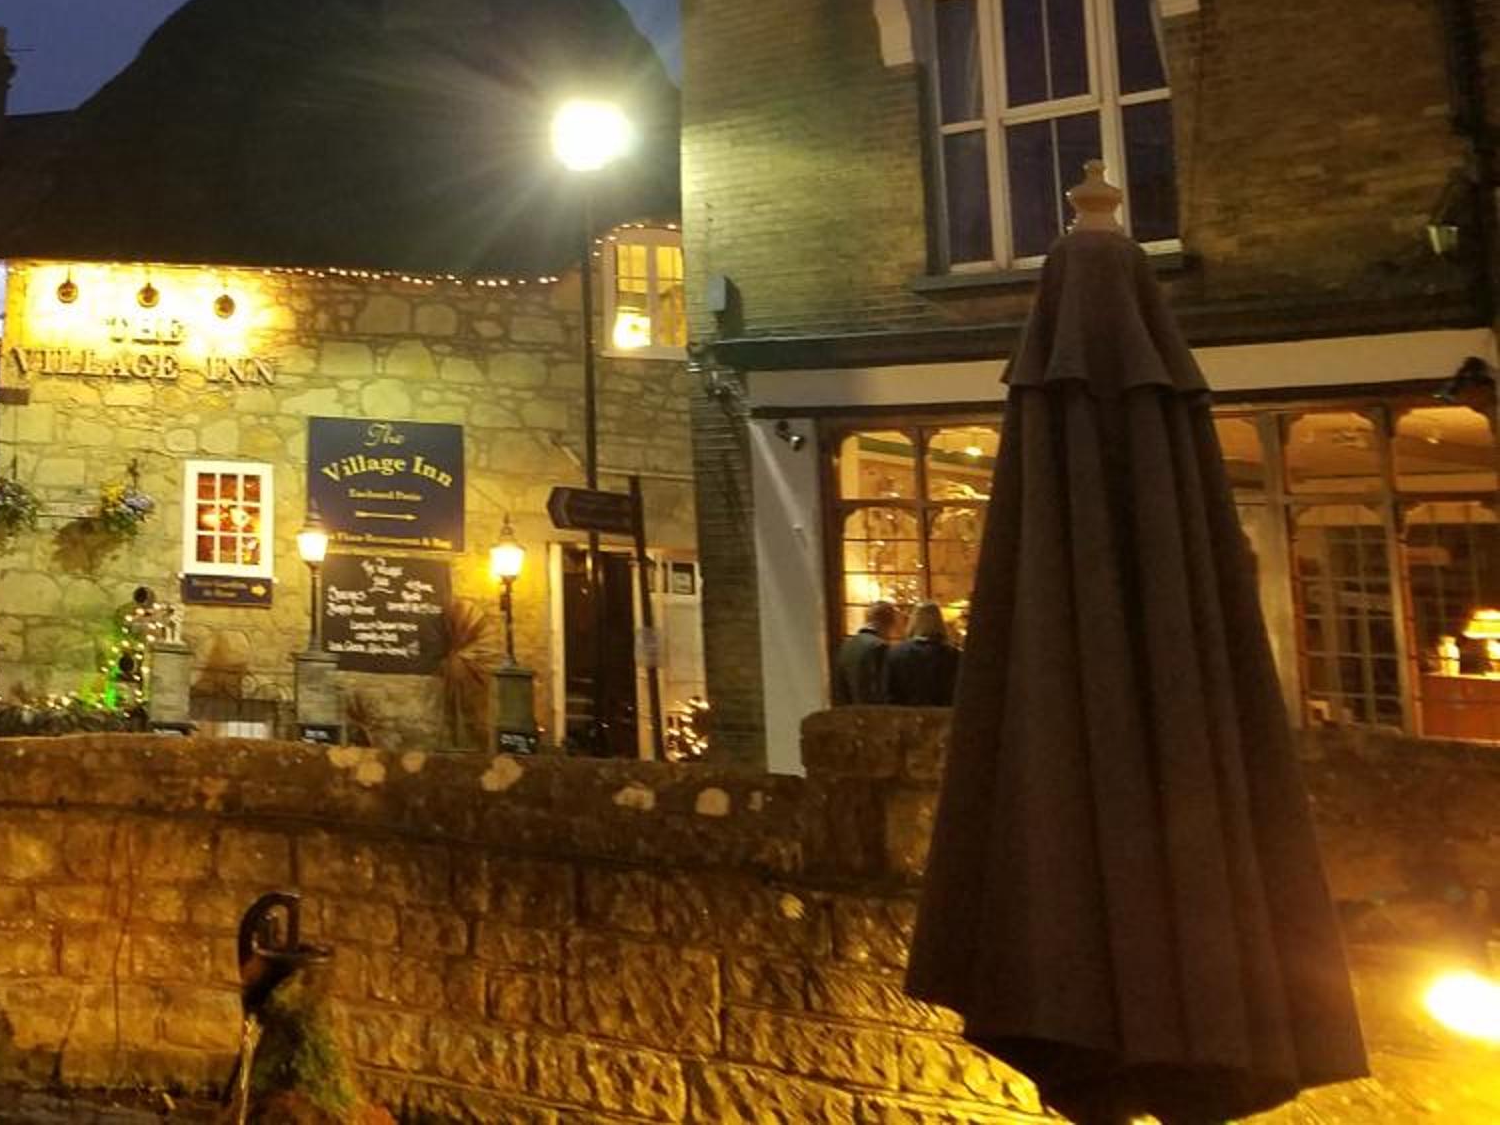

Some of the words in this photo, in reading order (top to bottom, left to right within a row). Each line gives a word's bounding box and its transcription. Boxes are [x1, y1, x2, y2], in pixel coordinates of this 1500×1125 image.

[10, 348, 179, 379] VILLAGE
[206, 356, 276, 385] INN
[363, 423, 406, 447] The
[321, 454, 407, 482] Village
[413, 456, 453, 488] Inn
